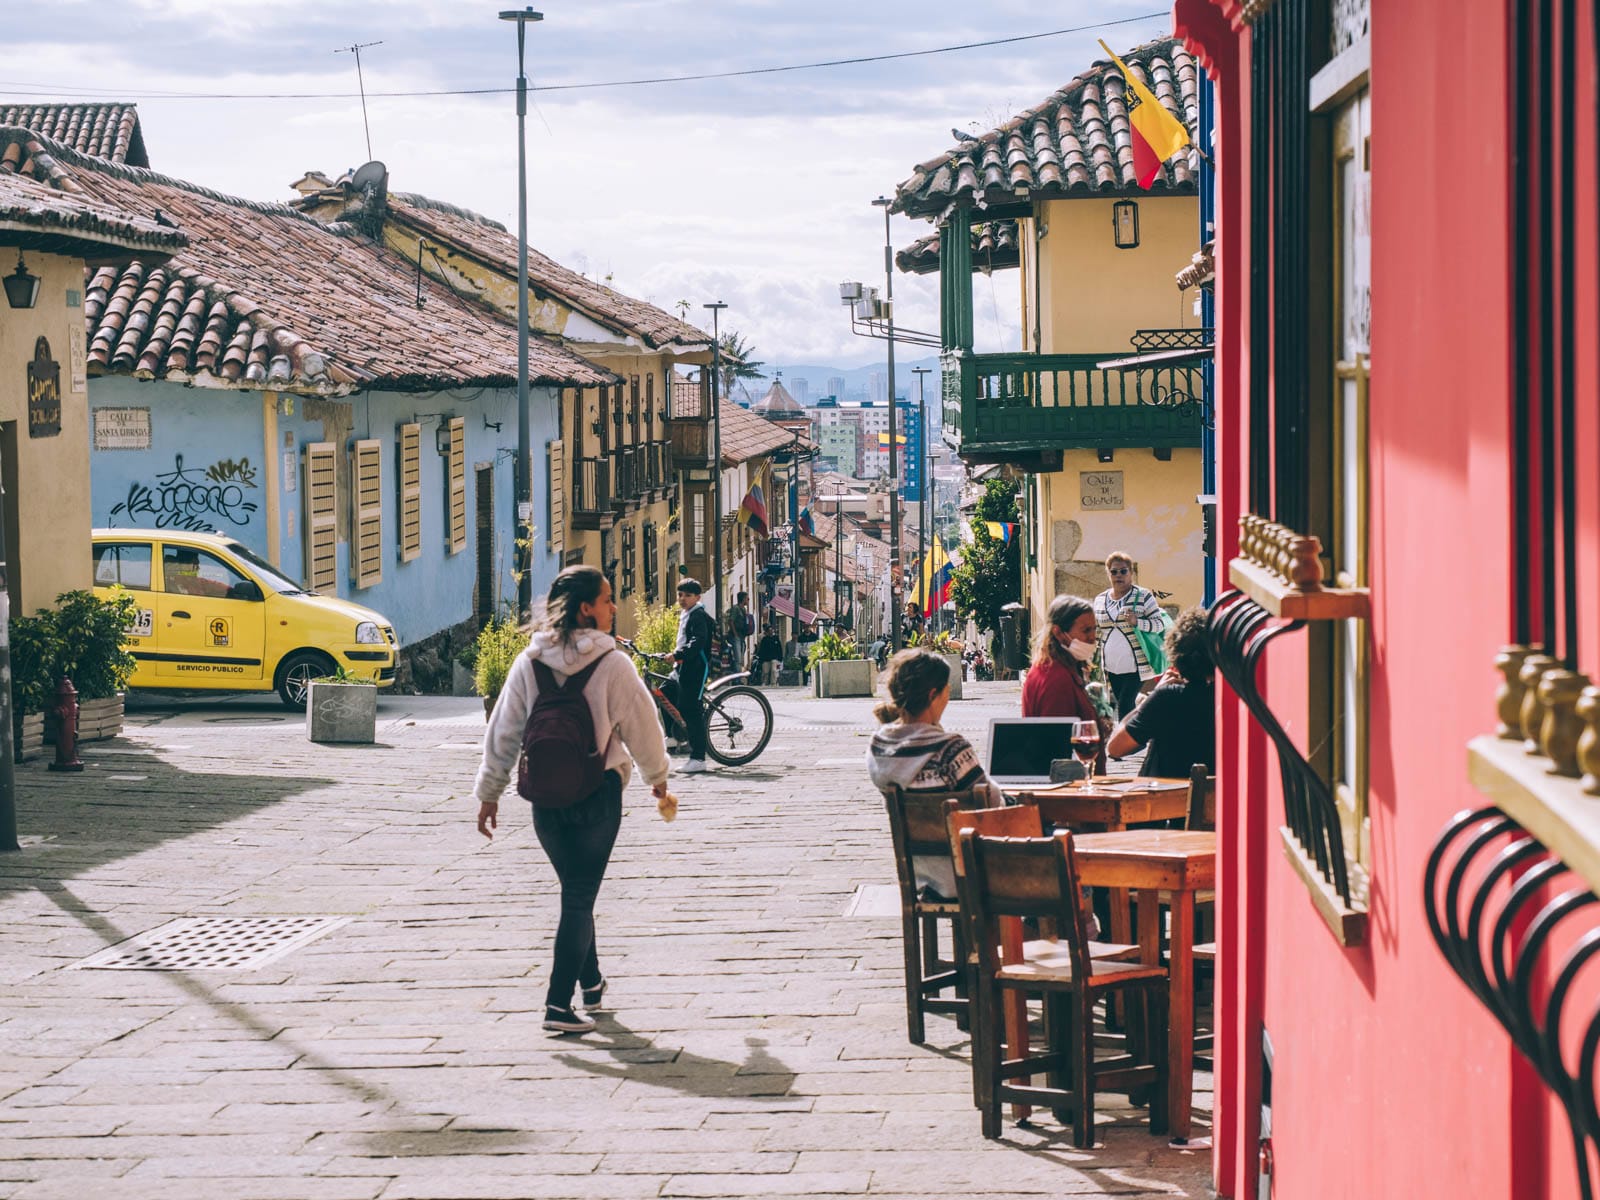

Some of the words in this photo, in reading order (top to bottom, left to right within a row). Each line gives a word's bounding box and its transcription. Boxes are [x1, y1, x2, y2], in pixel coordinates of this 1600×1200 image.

[110, 413, 133, 421] CALLE
[97, 428, 119, 437] SANTA
[215, 621, 224, 633] R
[176, 664, 211, 672] SERVICIO
[212, 665, 244, 673] PUBLICO
